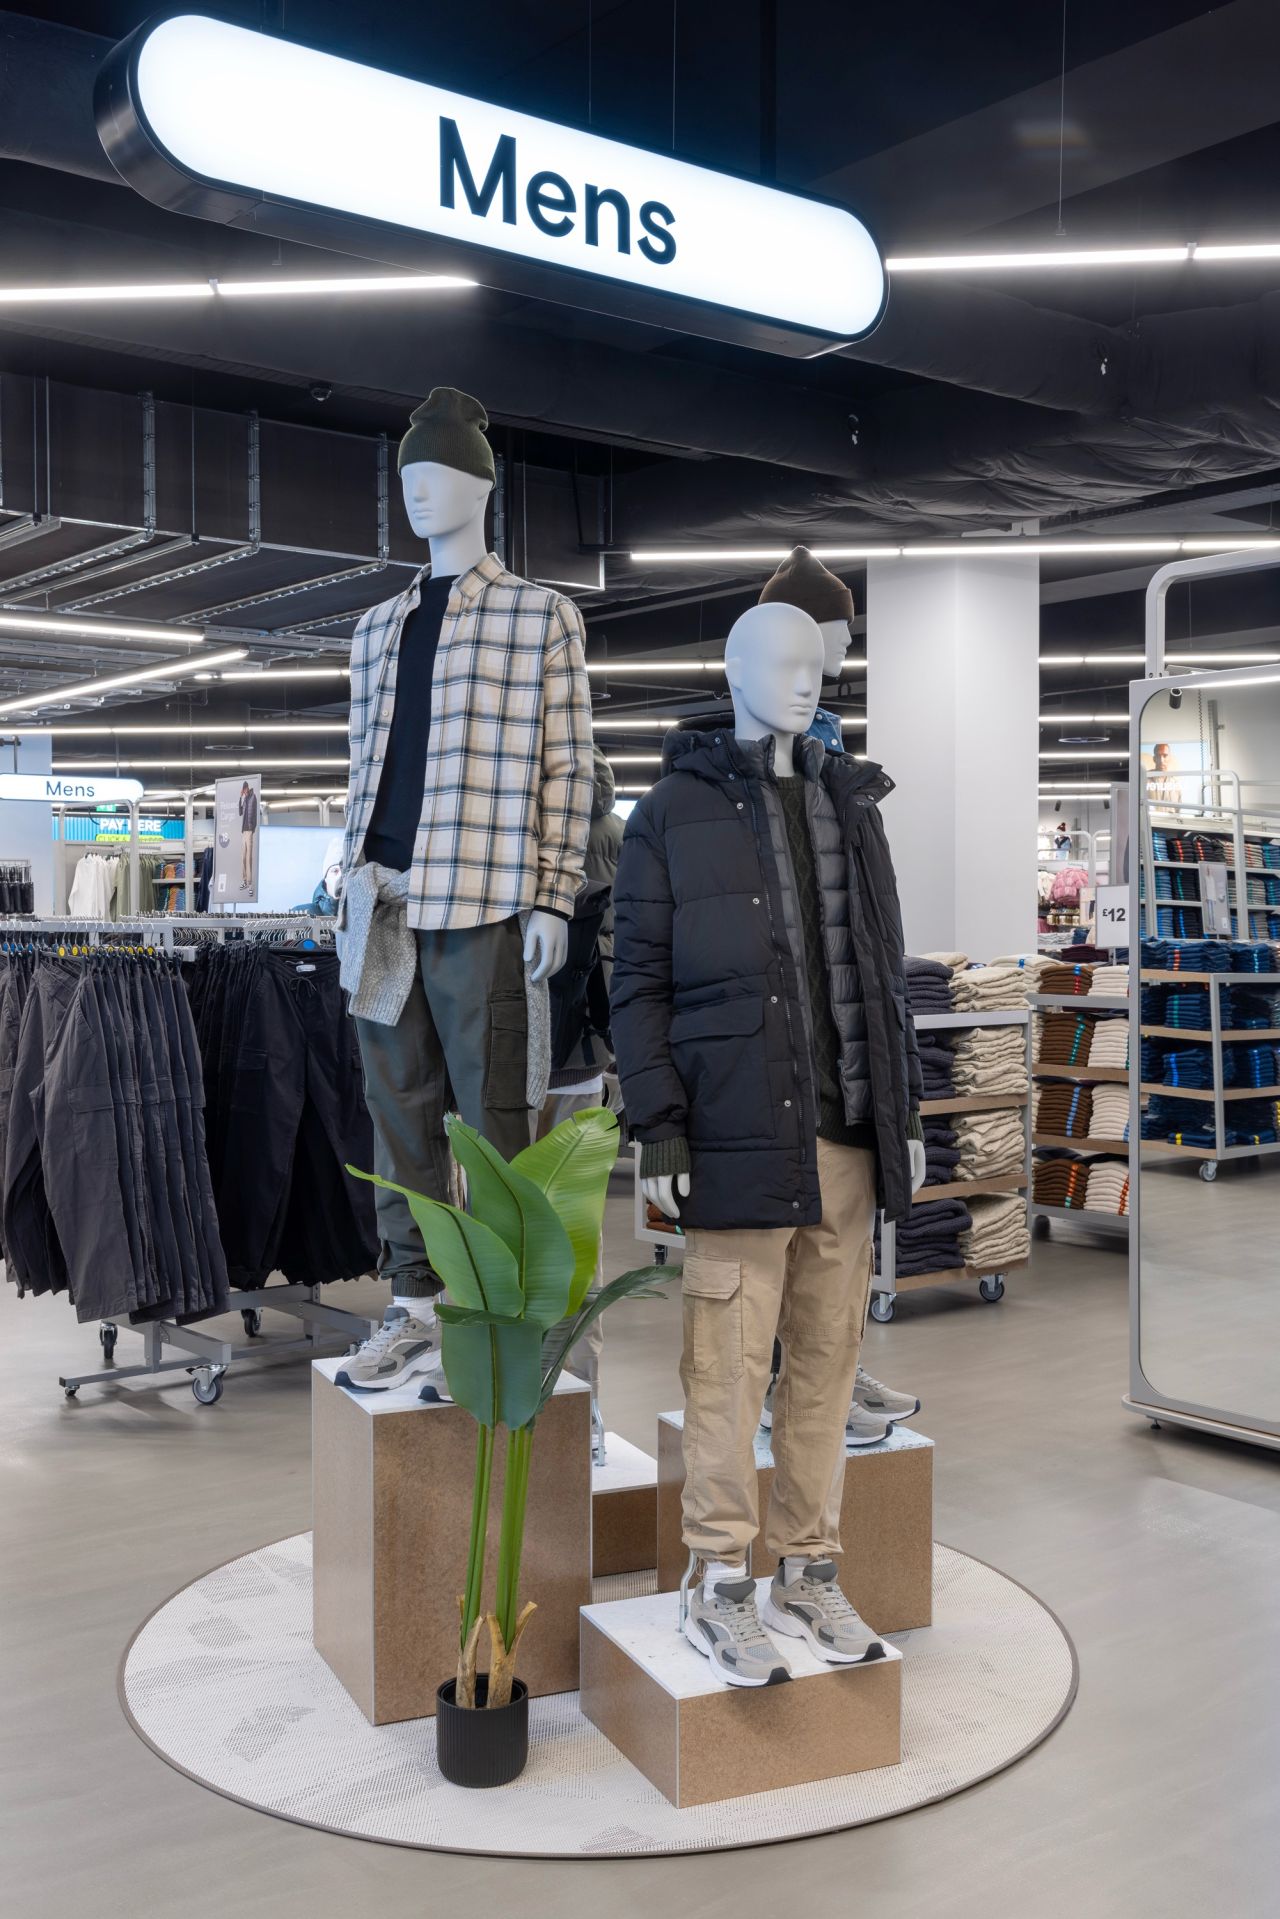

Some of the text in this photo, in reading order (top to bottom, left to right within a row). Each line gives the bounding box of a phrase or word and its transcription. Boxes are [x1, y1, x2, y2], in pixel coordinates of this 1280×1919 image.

[440, 116, 677, 265] Mens
[46, 781, 95, 797] Mens
[100, 818, 124, 831] PAY
[1102, 907, 1126, 922] £12
